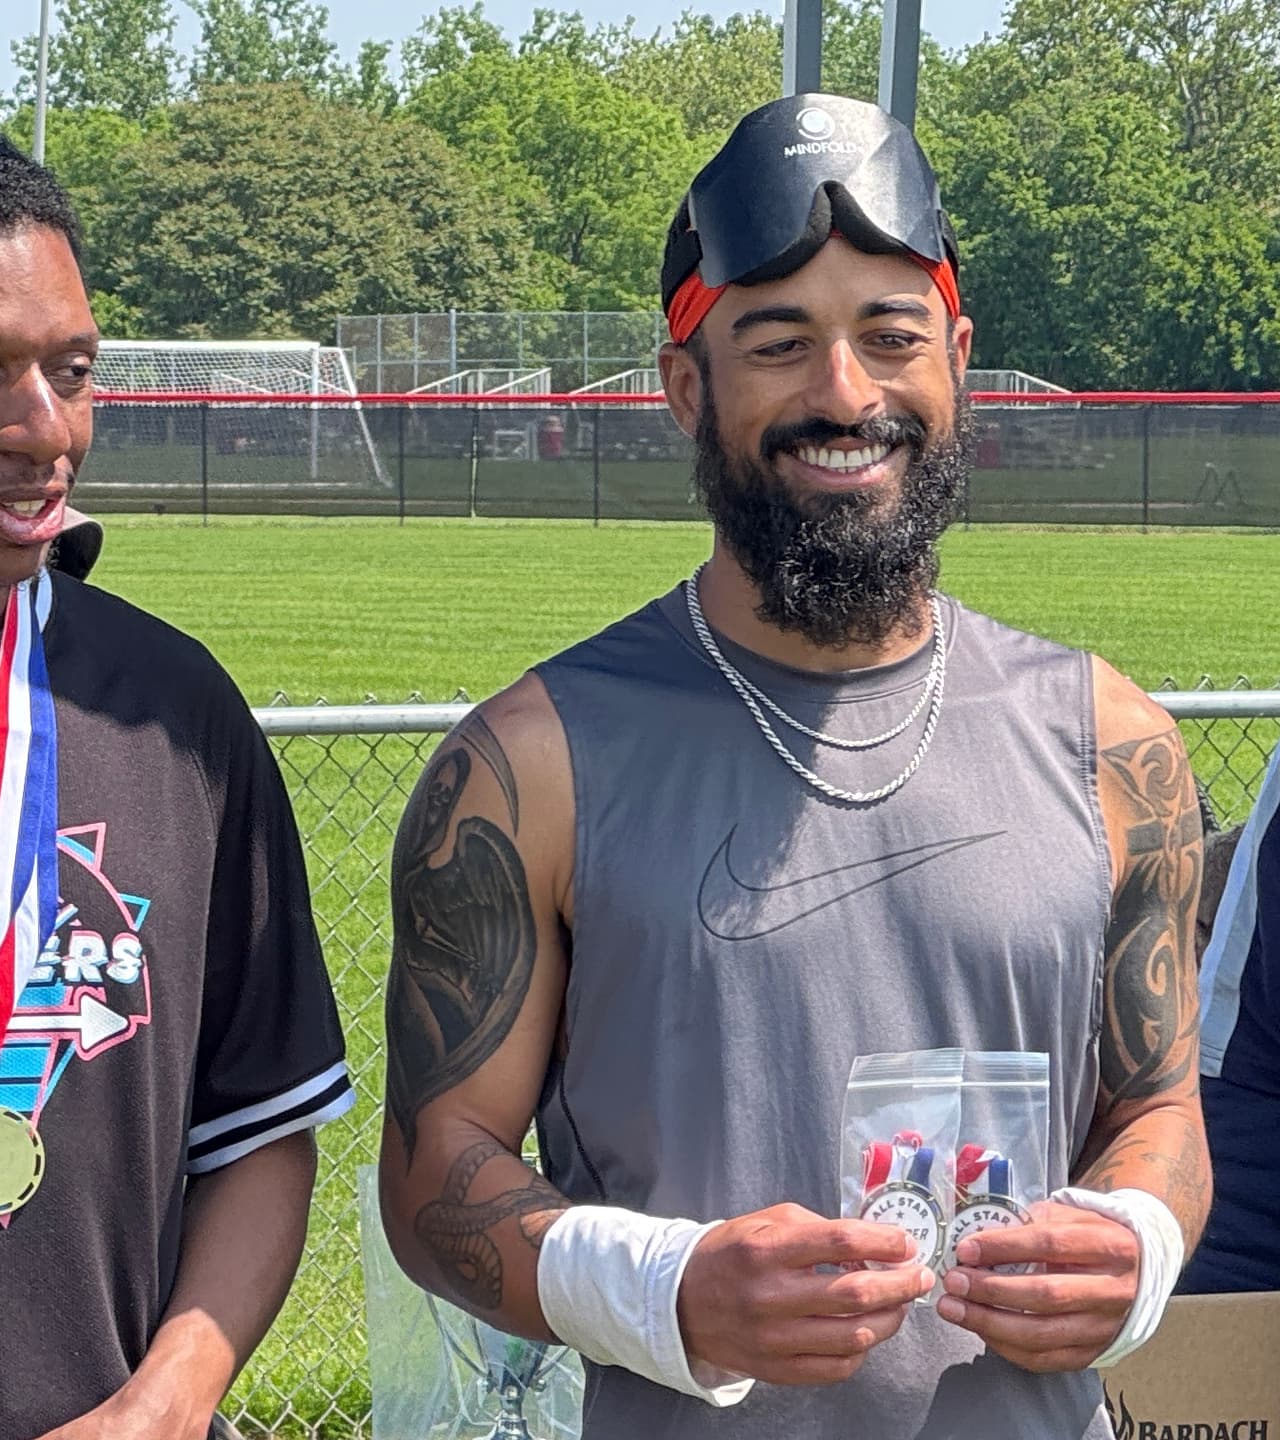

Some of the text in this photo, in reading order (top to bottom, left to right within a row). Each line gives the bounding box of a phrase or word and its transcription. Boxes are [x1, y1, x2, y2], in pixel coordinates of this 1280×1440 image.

[783, 141, 857, 158] MINDFOLD
[872, 1197, 929, 1221] ALL STAR
[973, 1211, 1010, 1225] STAR
